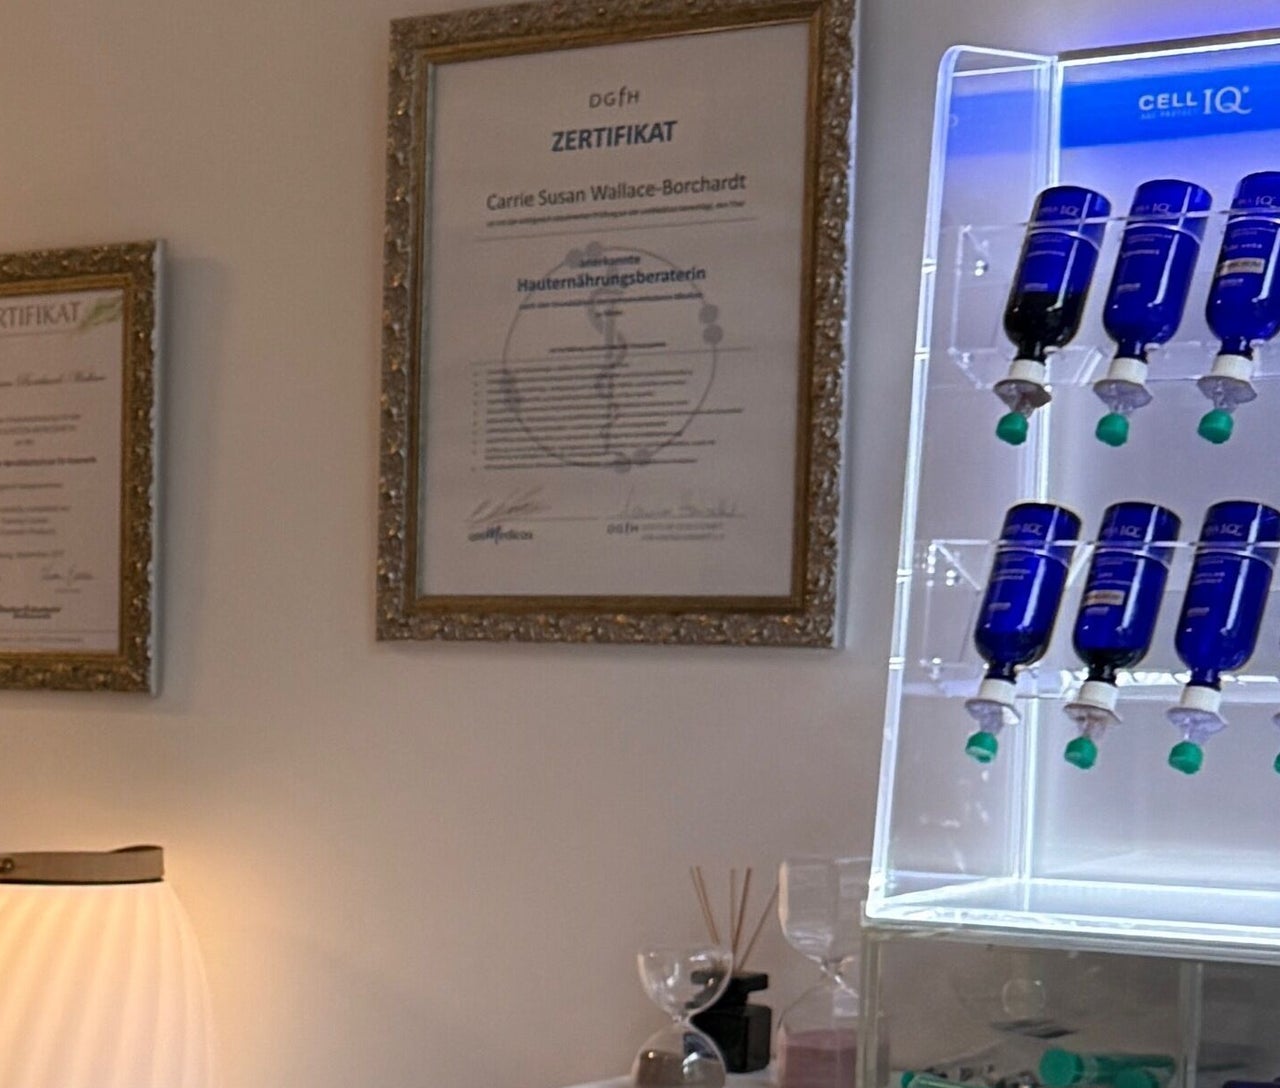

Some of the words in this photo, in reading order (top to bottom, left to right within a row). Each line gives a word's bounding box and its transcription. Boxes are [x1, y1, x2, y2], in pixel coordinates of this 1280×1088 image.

[589, 83, 640, 108] DGfH
[1138, 91, 1198, 111] CELL
[551, 120, 677, 152] ZERTIFIKAT
[486, 193, 535, 211] Carrie
[538, 187, 587, 204] Susan
[590, 172, 747, 202] Wallace-Borchardt
[517, 267, 706, 293] Hauternährungsberaterin
